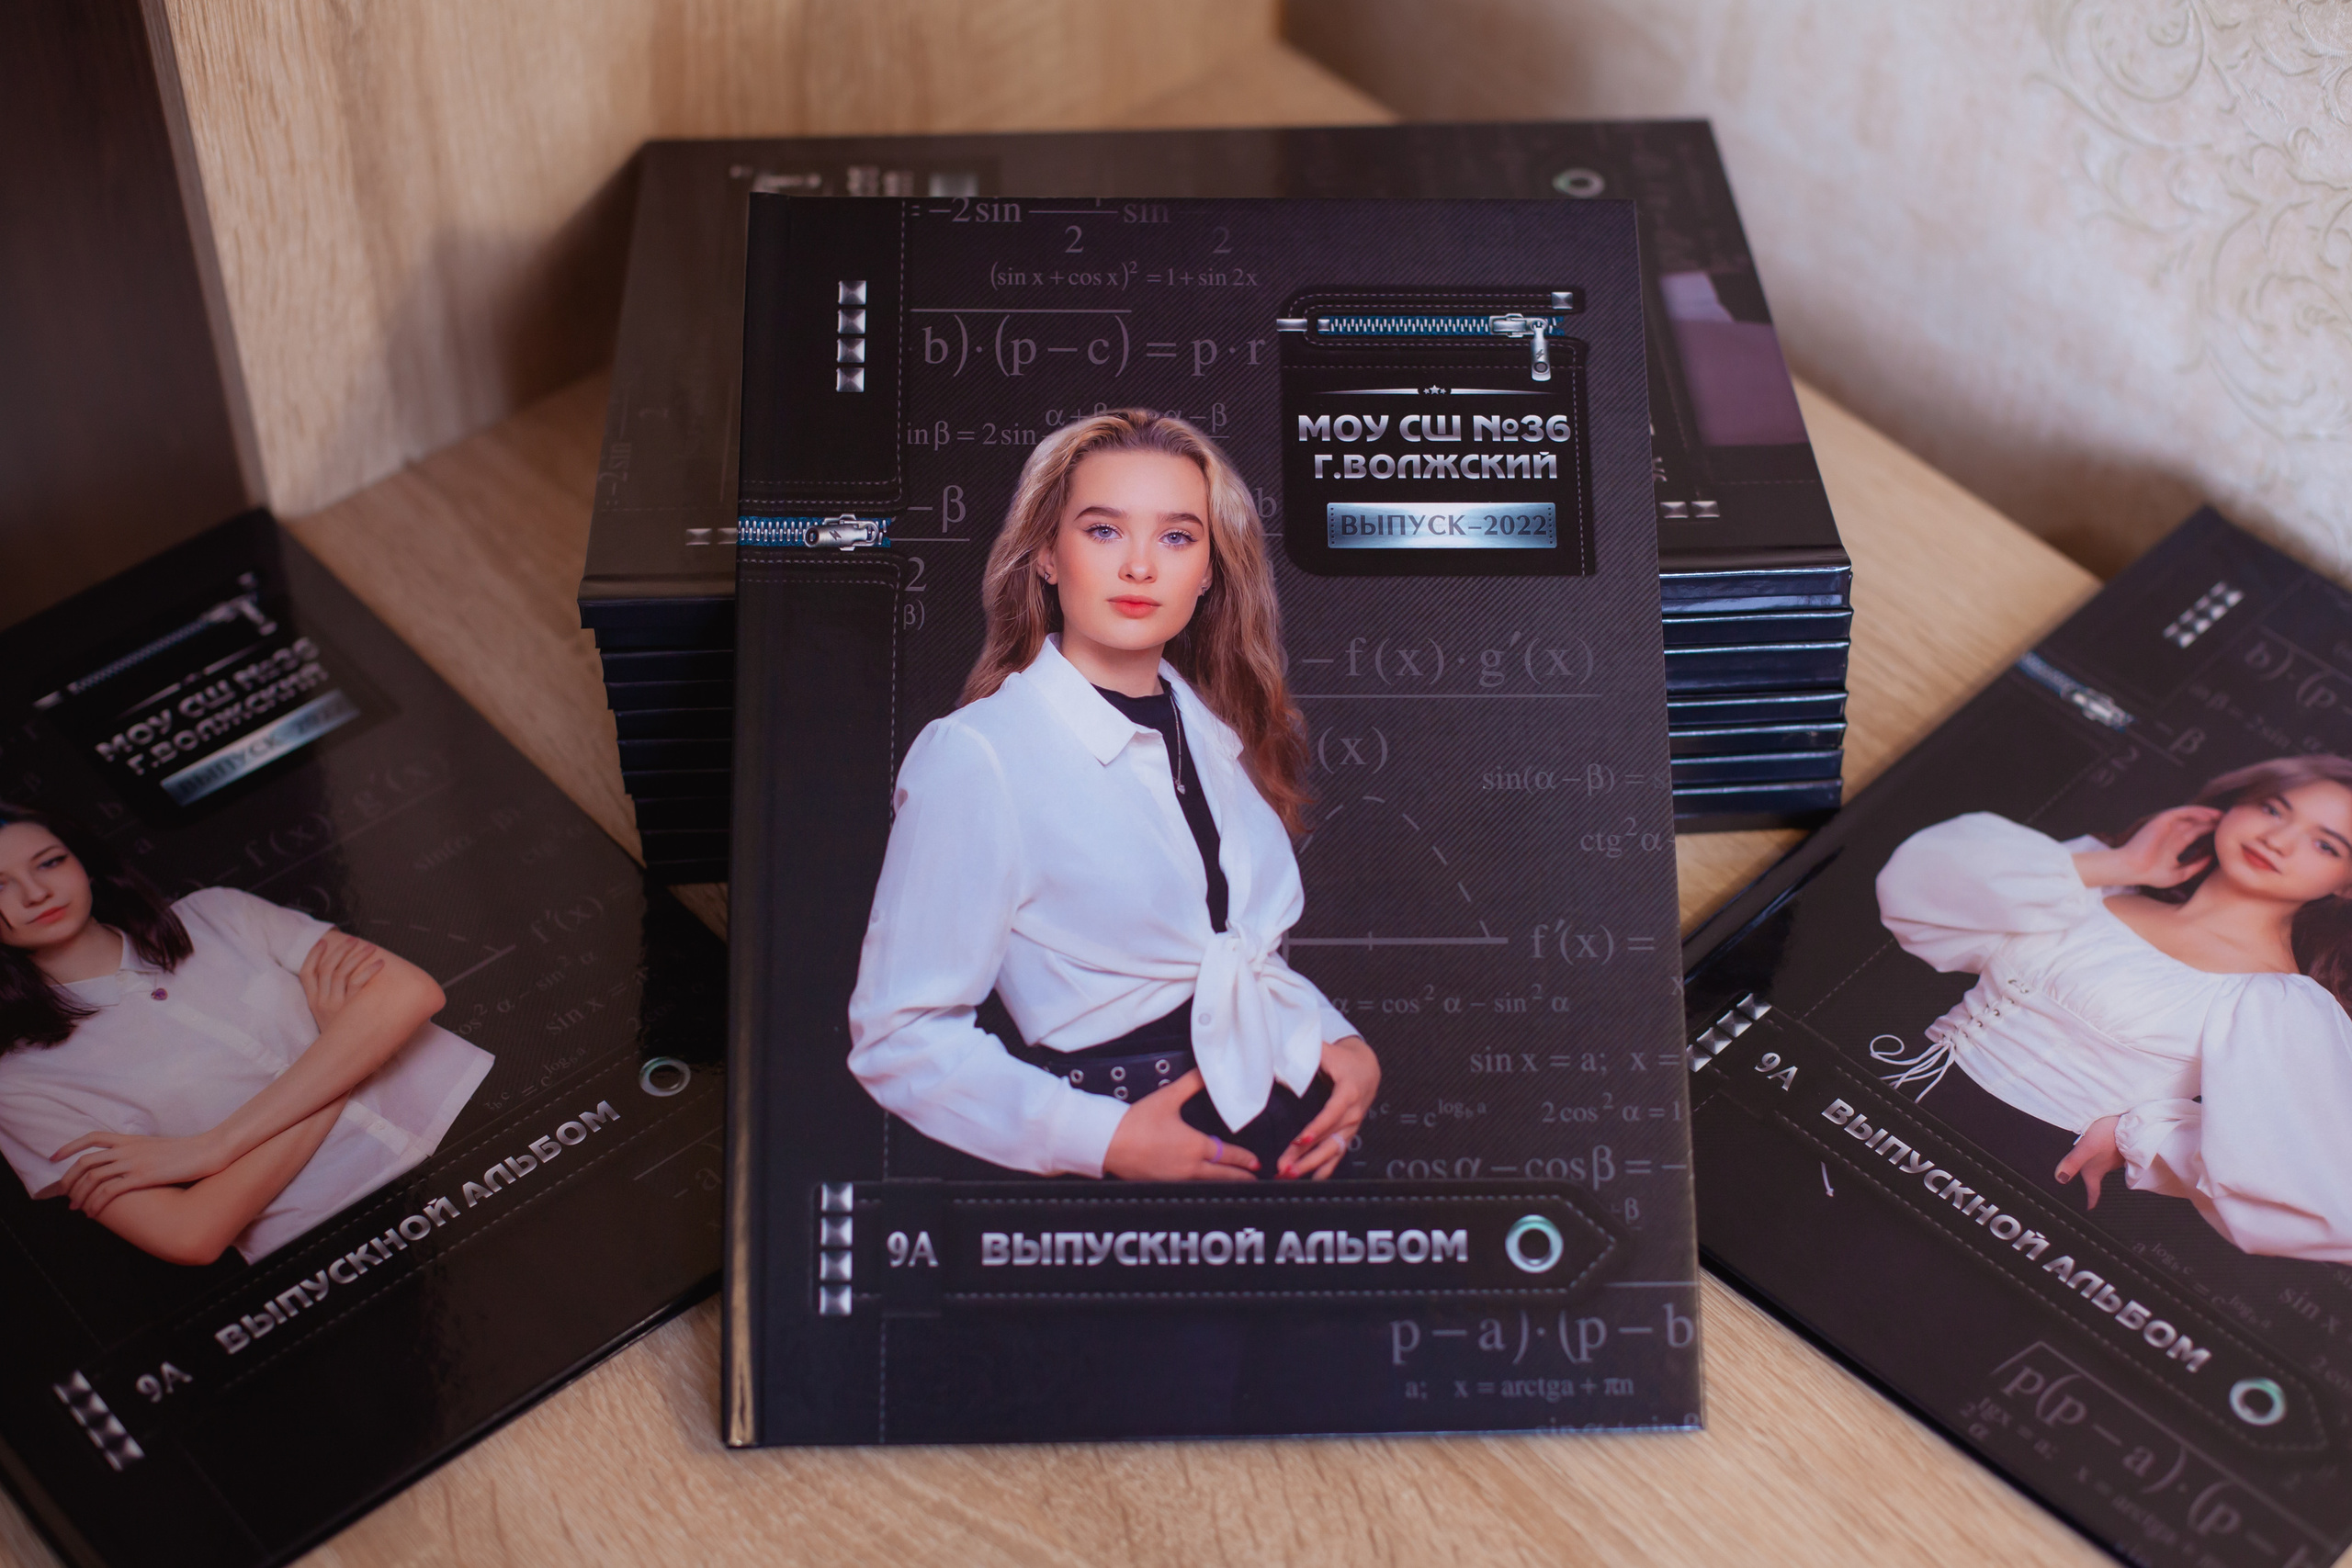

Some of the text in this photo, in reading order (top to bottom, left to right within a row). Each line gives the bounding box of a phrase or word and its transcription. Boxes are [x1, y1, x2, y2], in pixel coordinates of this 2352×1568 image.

[1298, 414, 1571, 442] МОУ СШ №36
[1314, 452, 1558, 479] Г.ВОЛЖСКИЙ
[213, 1195, 461, 1356] ВЫПУСКНОЙ
[460, 1100, 621, 1208] АЛЬБОМ
[1754, 1051, 2212, 1373] 9А ВЫПУСКНОЙ АЛЬБОМ
[888, 1228, 1469, 1268] 9А ВЫПУСКНОЙ АЛЬБОМ
